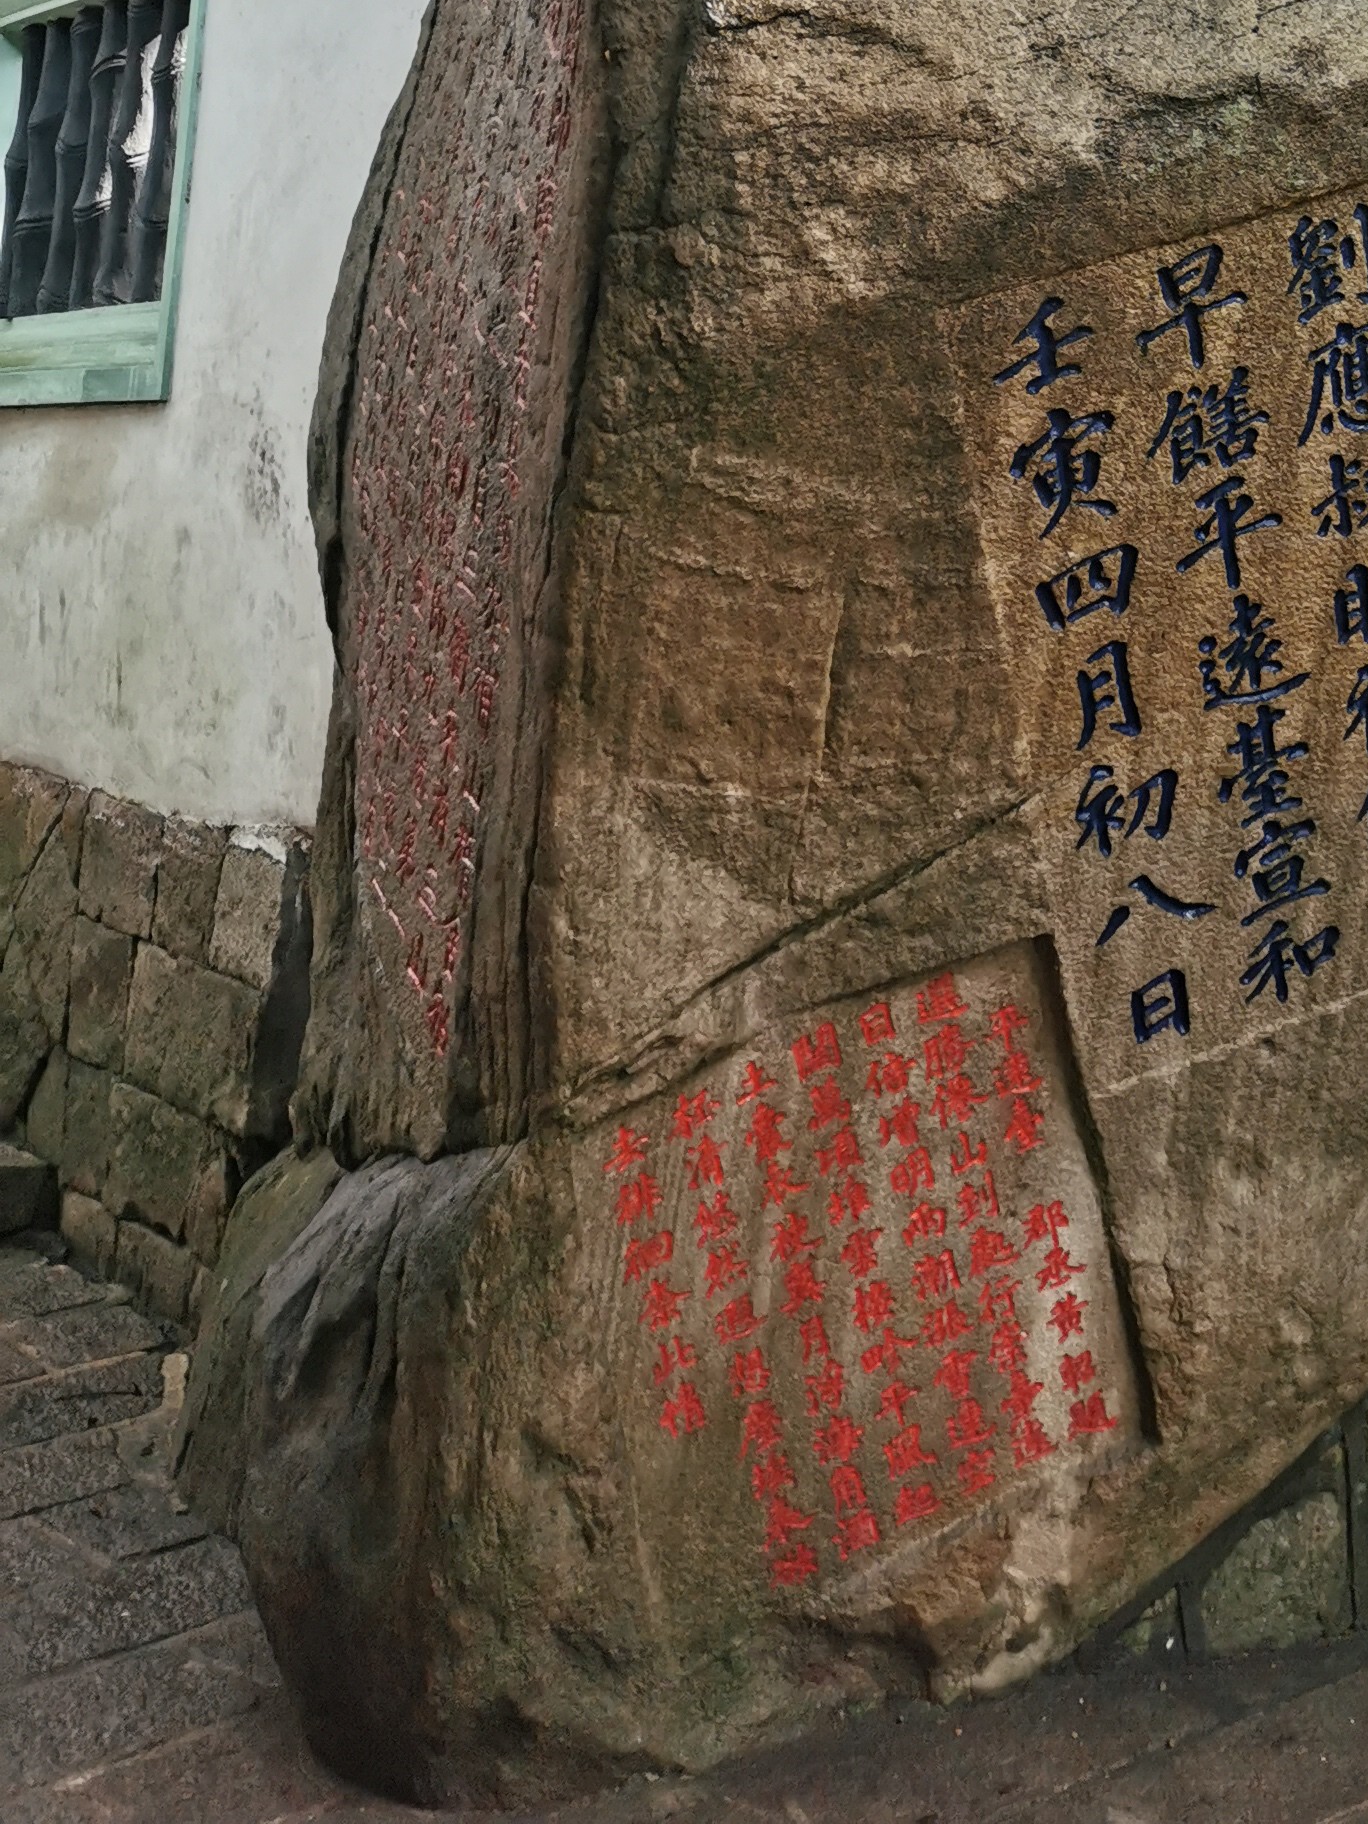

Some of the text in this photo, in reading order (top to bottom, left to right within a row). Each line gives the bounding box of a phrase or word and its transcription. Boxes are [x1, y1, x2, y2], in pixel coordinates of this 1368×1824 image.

[992, 294, 1219, 1046] 壬寅四月初八日
